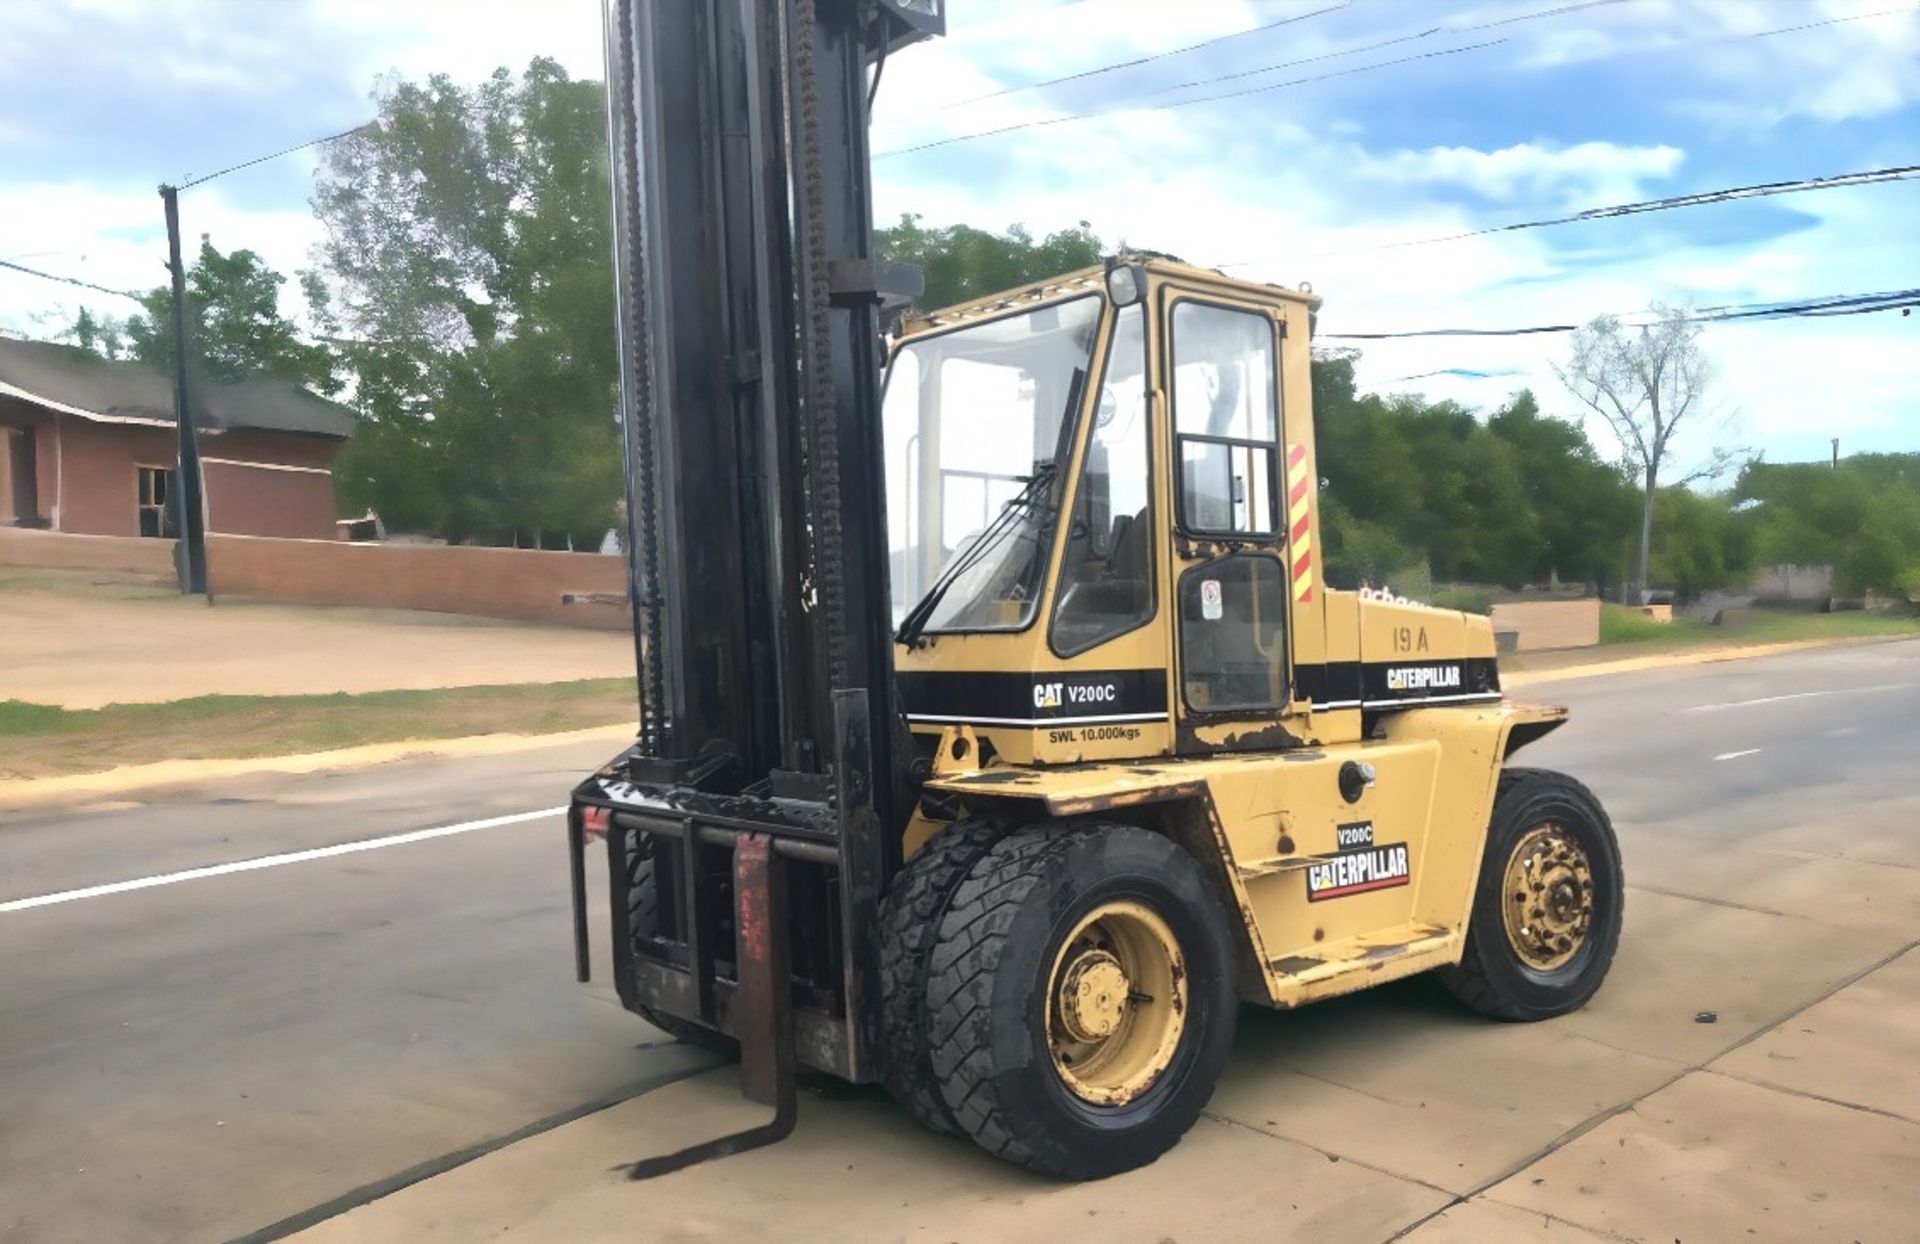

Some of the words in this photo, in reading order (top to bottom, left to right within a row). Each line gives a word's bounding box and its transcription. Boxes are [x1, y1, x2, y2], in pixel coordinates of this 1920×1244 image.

[1393, 626, 1411, 653] 19
[1417, 626, 1429, 652] A
[1387, 665, 1460, 690] CATERPILLAR
[1034, 683, 1064, 708] CAT
[1068, 684, 1115, 703] V200C
[1049, 730, 1077, 743] SWL
[1080, 726, 1140, 741] 10.000kgs
[1338, 825, 1372, 845] V200C
[1309, 847, 1408, 891] CATERPILLAR
